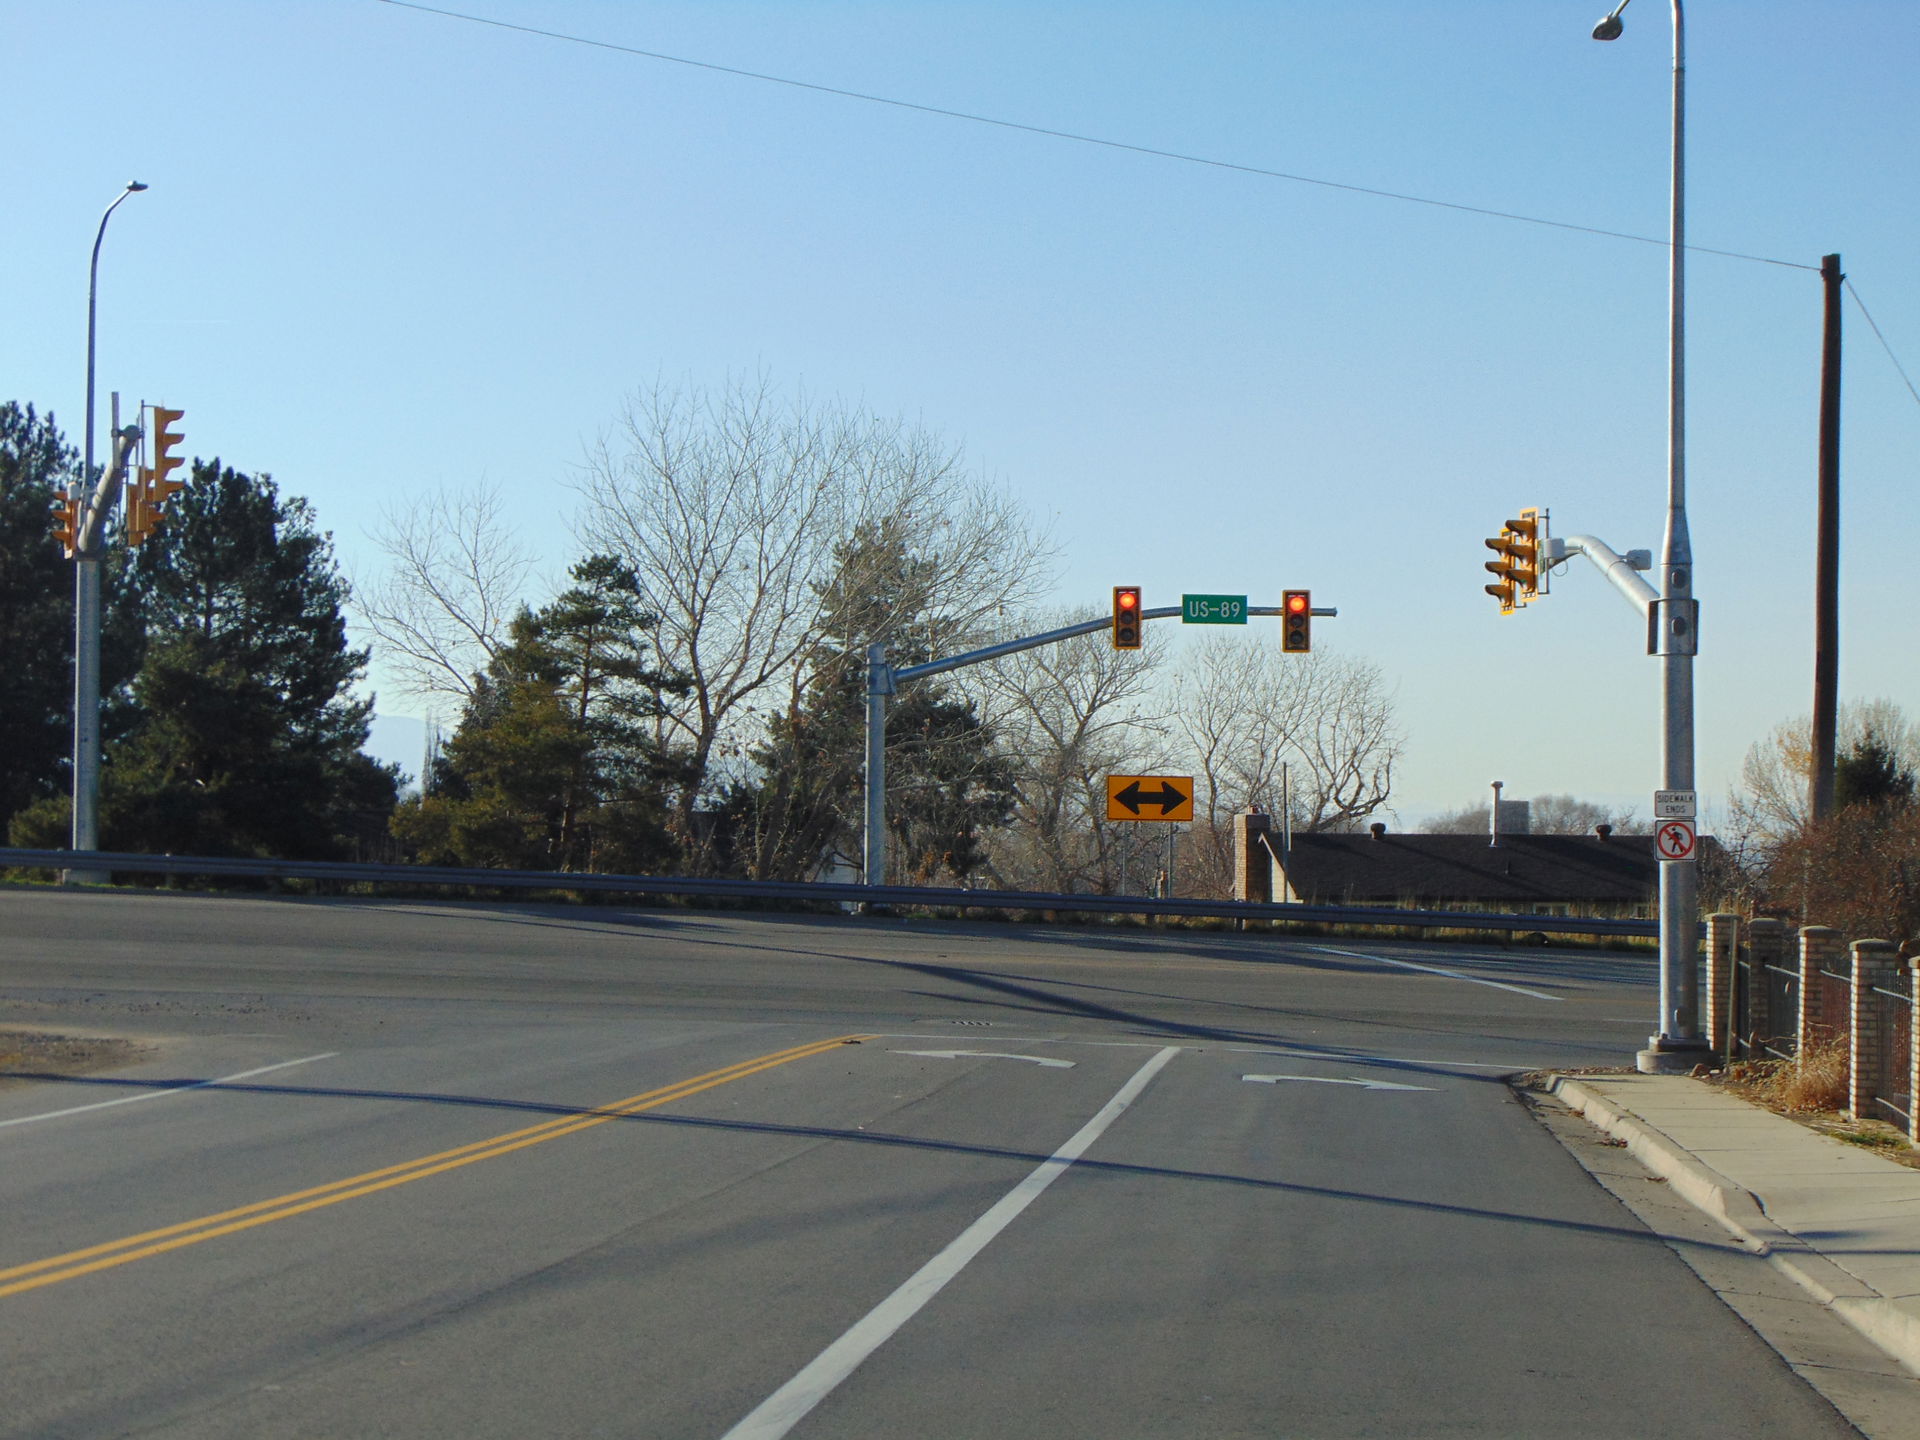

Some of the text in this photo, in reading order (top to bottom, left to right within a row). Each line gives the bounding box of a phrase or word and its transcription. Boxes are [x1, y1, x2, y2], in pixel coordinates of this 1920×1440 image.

[1189, 601, 1240, 618] US-89
[1657, 794, 1694, 803] SIDEWALK
[1665, 805, 1686, 814] ENDS
